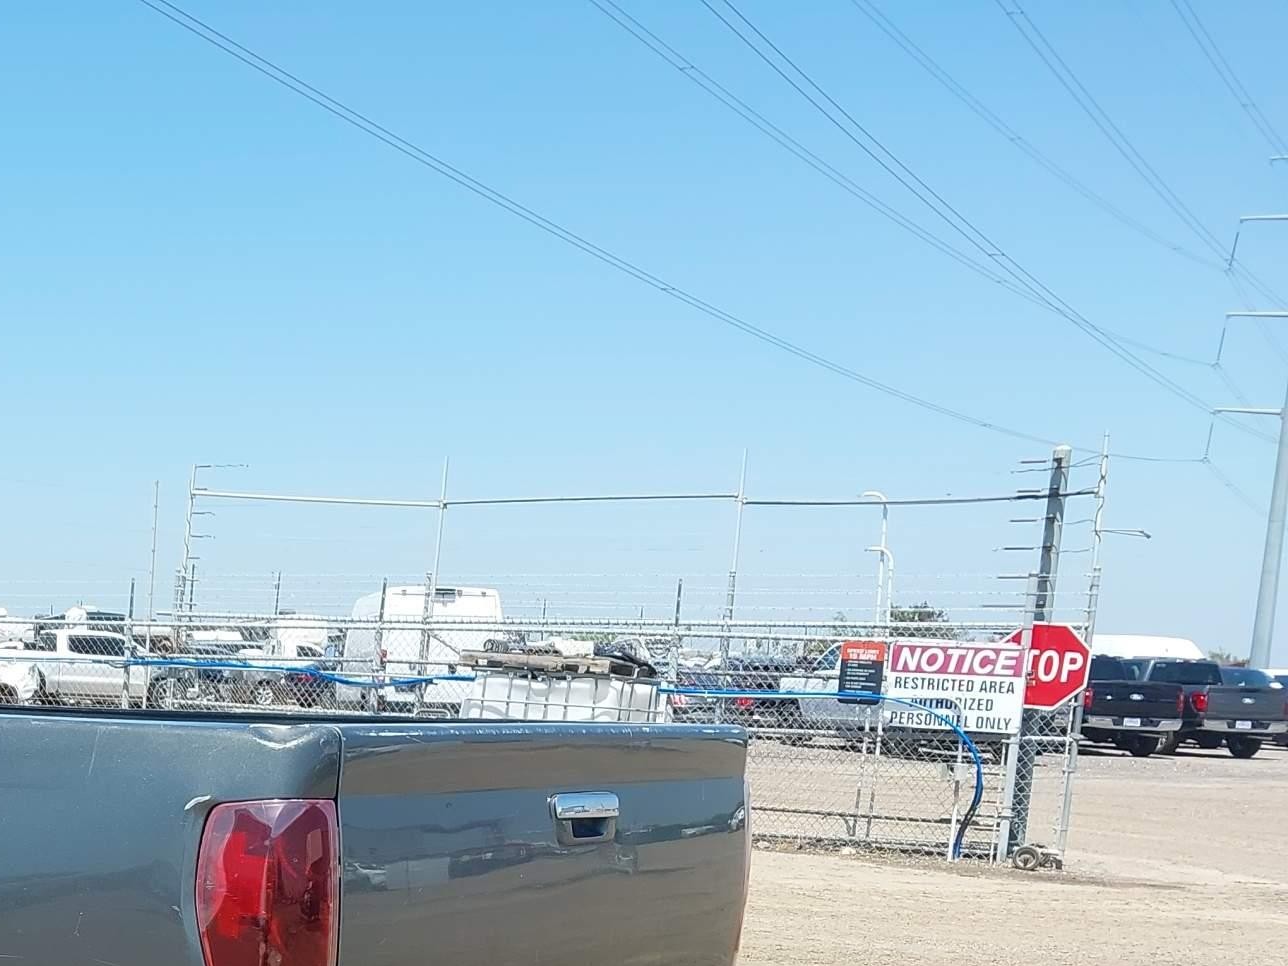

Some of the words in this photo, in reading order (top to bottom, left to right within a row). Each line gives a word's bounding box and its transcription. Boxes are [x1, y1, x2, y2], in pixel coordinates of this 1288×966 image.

[896, 647, 1019, 675] NOTICE
[1025, 648, 1084, 683] TOP
[894, 676, 974, 692] RESTRICTED
[979, 680, 1014, 694] AREA
[976, 716, 1012, 731] ONLY
